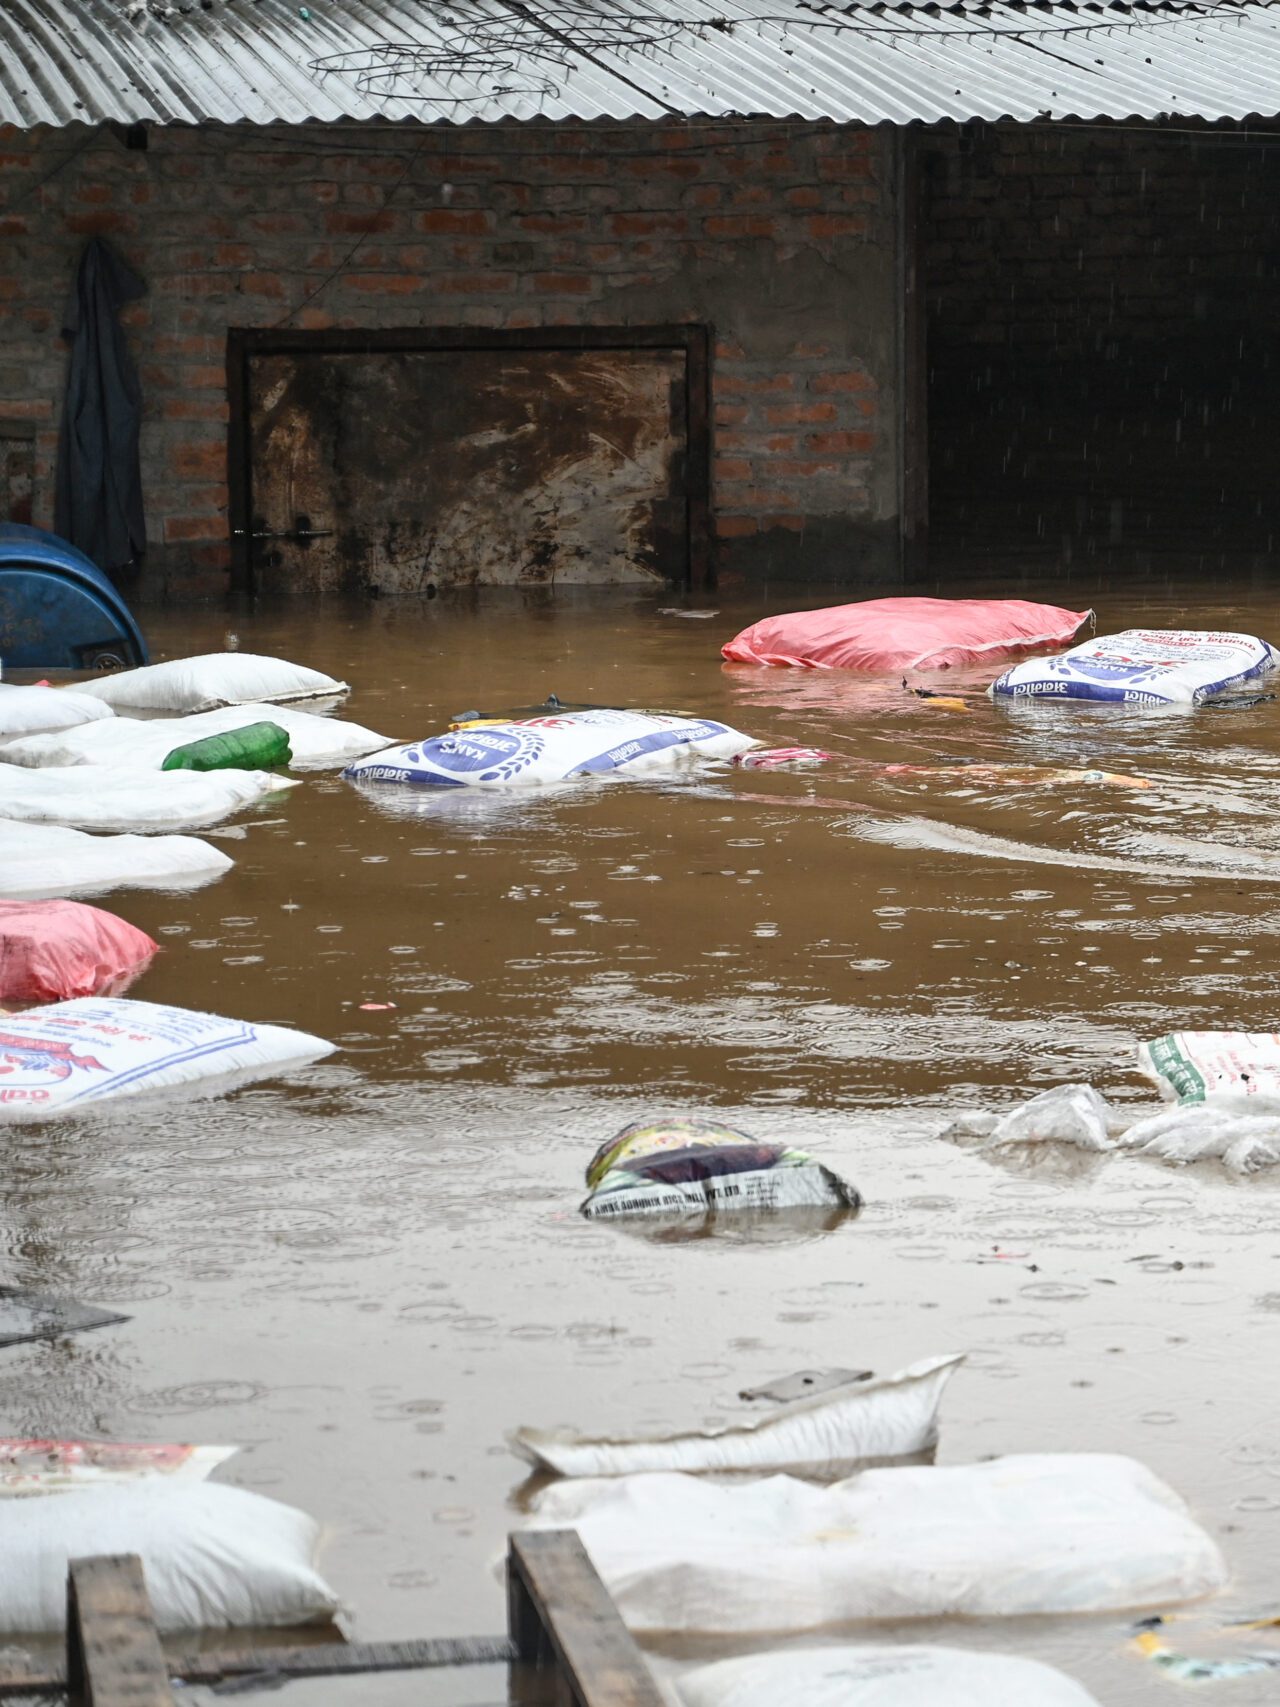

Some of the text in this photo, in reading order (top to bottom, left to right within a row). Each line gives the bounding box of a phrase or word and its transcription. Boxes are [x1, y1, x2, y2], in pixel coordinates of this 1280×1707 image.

[1013, 681, 1069, 698] अनमोल
[439, 741, 487, 761] KAM'S
[607, 741, 644, 762] अनमोल
